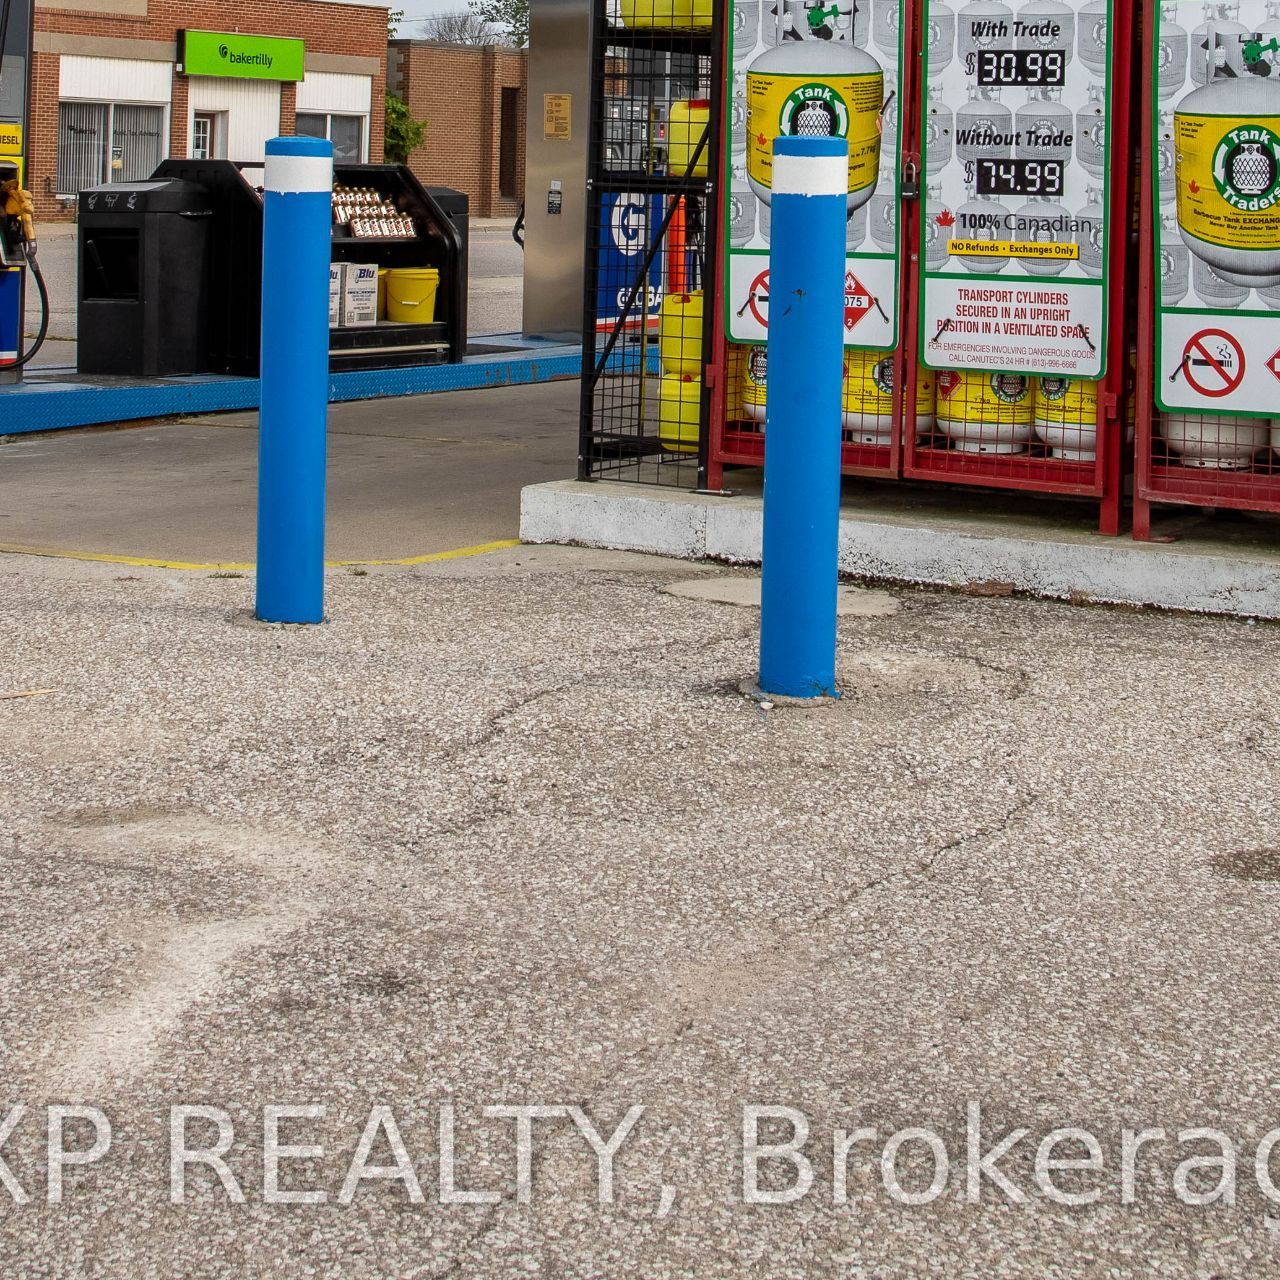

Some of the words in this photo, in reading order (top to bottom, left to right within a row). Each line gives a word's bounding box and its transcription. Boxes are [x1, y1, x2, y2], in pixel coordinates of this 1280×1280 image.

[972, 21, 1008, 37] With
[1013, 20, 1060, 37] Trade
[230, 52, 273, 69] bakertilly
[795, 87, 833, 100] Tank
[956, 129, 1021, 146] Without
[1026, 130, 1073, 147] Trade
[1228, 130, 1271, 144] Tank
[960, 214, 1000, 230] 100%
[1004, 214, 1092, 233] Canadian
[952, 242, 963, 251] NO
[966, 243, 999, 252] Refunds
[1009, 244, 1053, 255] Exchanges
[1054, 246, 1074, 256] Only
[844, 296, 863, 307] 075
[958, 288, 1014, 303] TRANSPORT
[1016, 291, 1068, 305] CYLINDERS
[956, 304, 998, 318] SECURED
[1001, 306, 1011, 318] IN
[1014, 307, 1027, 320] AN
[1030, 308, 1071, 322] UPRIGHT
[847, 318, 853, 326] 2
[937, 320, 979, 333] POSITION
[982, 322, 991, 334] IN
[994, 322, 1001, 334] A
[1003, 323, 1058, 337] VENTILATED
[944, 343, 991, 353] EMERGENCIES
[992, 345, 1027, 355] INVOLVING
[1028, 348, 1070, 358] DANGEROUS
[948, 354, 966, 363] CALL
[1015, 357, 1025, 366] HR
